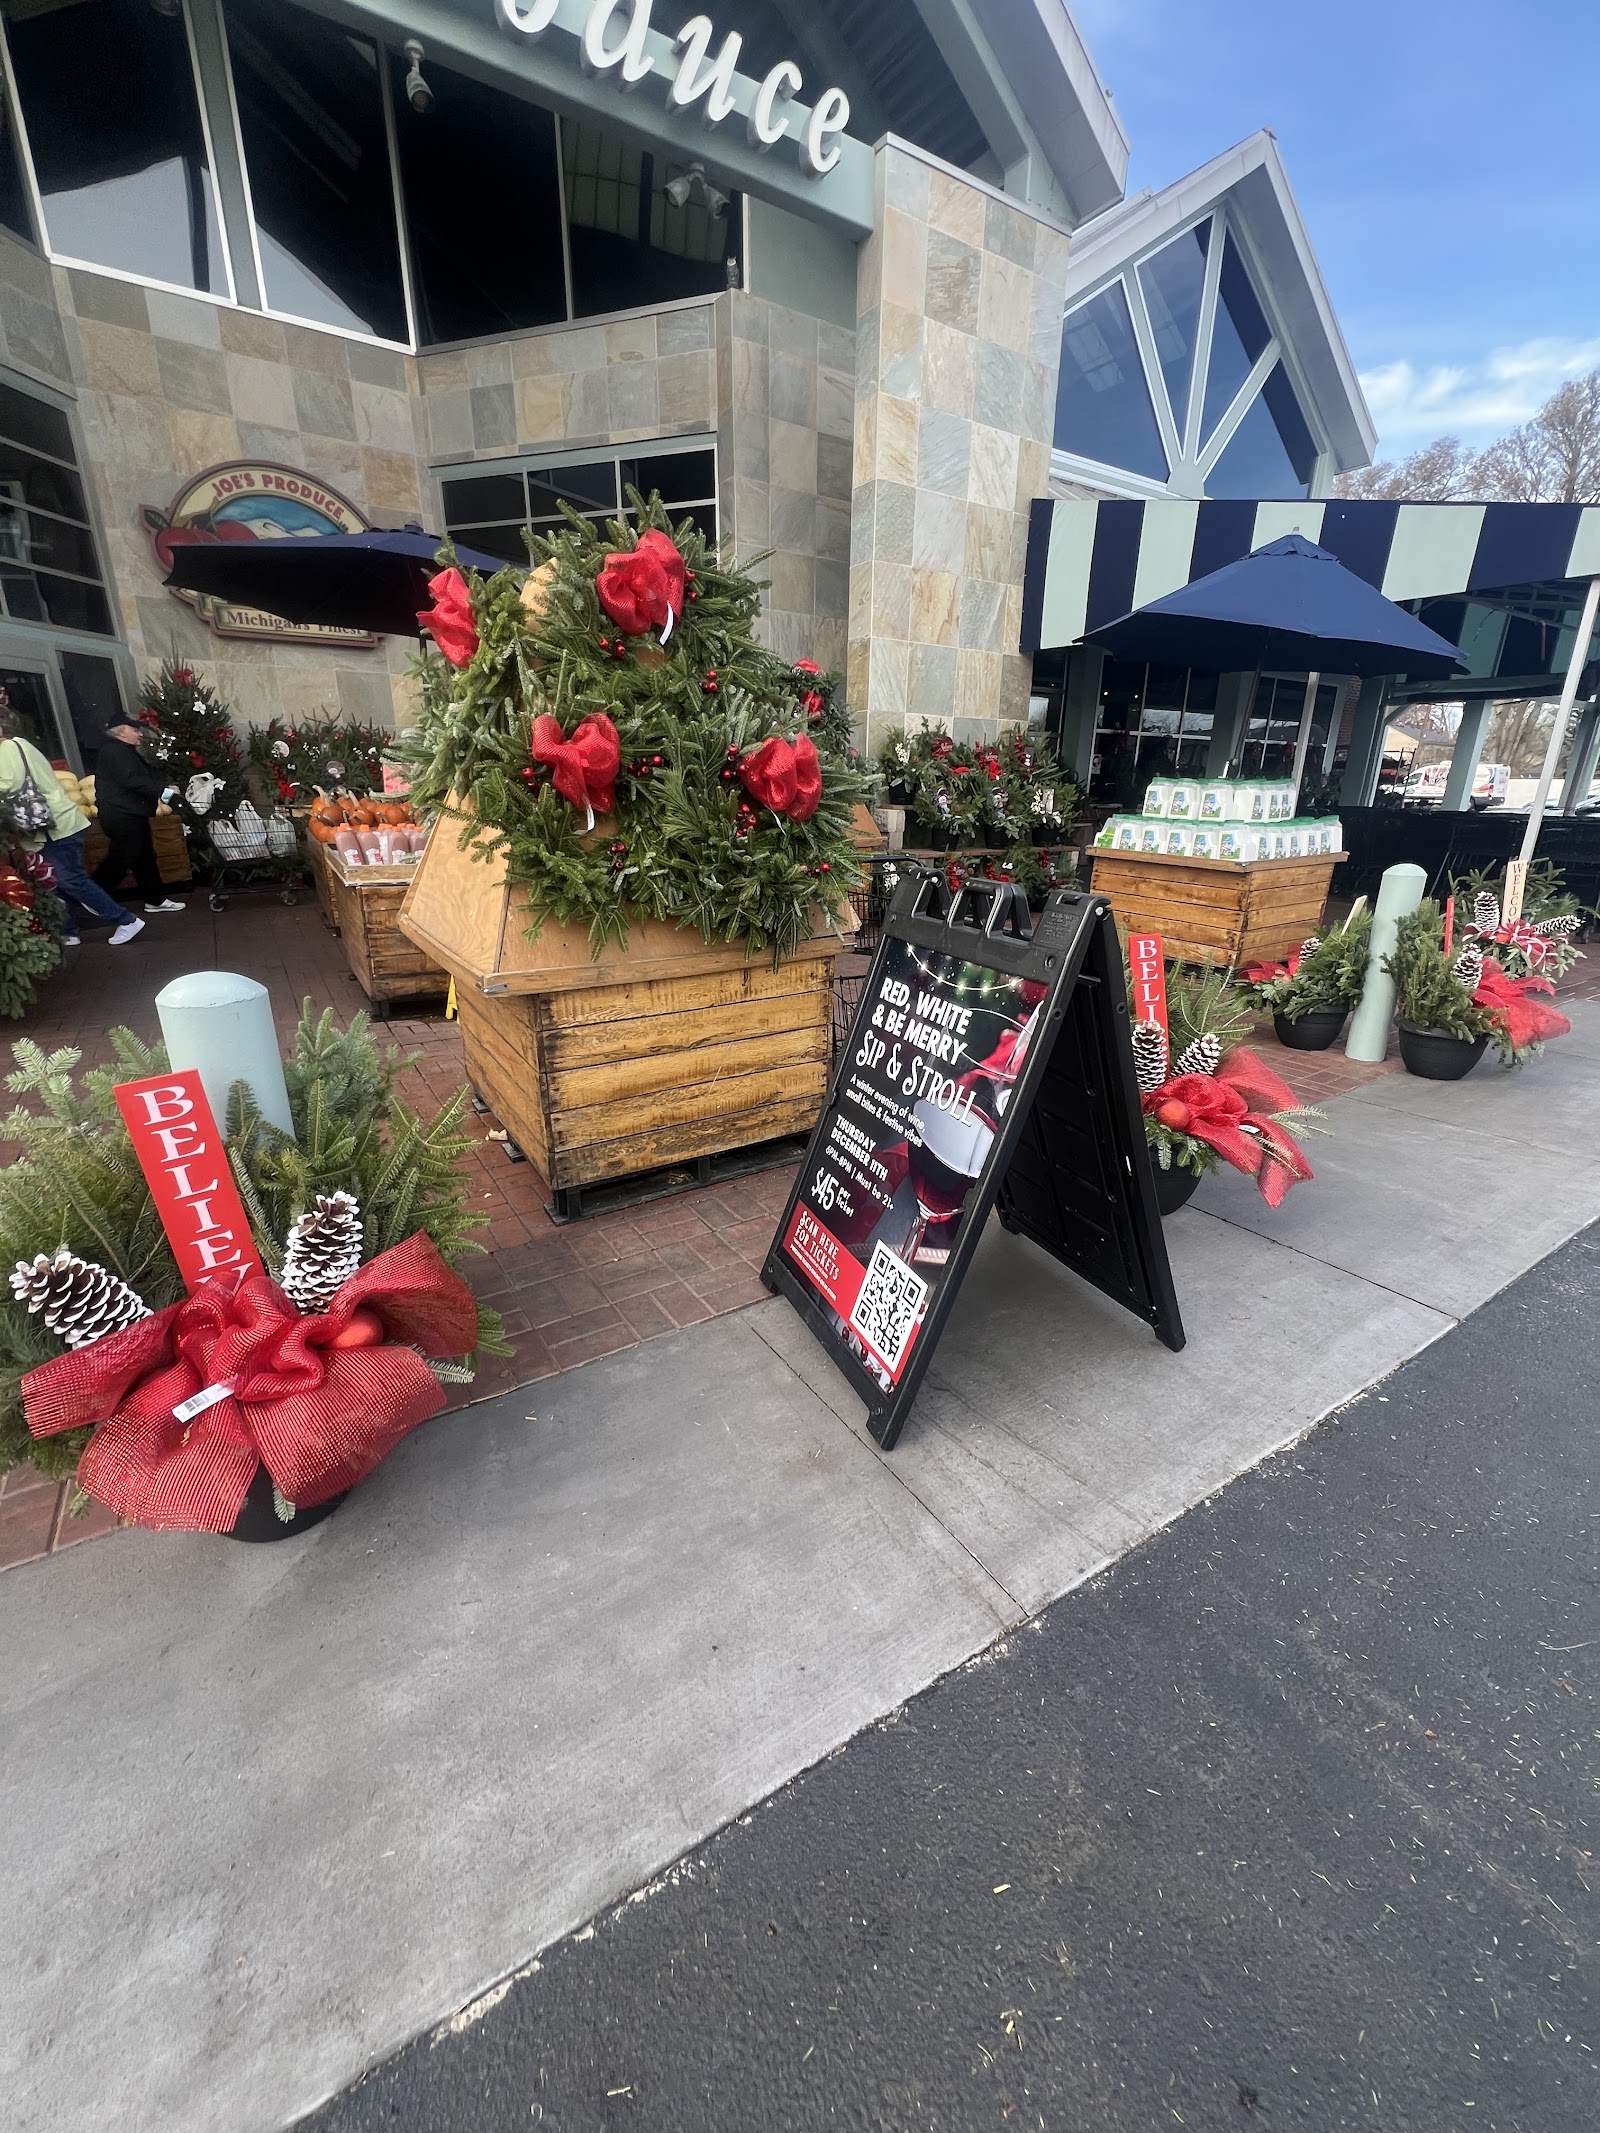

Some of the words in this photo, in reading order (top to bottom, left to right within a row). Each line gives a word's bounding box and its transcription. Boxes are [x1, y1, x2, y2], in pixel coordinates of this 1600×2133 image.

[212, 472, 255, 498] JOE'S
[261, 473, 345, 520] PRODUCE
[1507, 862, 1524, 922] WELCO
[880, 977, 911, 1014] RED,
[915, 990, 973, 1035] WHITE
[871, 1003, 885, 1028] &
[884, 1008, 907, 1037] BE
[903, 1018, 968, 1066] MERRY
[886, 1042, 902, 1081] &
[845, 1087, 862, 1107] small
[861, 1095, 877, 1115] bites
[876, 1106, 882, 1119] &
[882, 1110, 904, 1135] festive
[904, 1124, 923, 1148] vibes
[850, 1073, 856, 1084] A
[855, 1078, 875, 1096] winter
[873, 1090, 899, 1117] evening
[899, 1106, 910, 1119] of
[907, 1111, 926, 1133] wine,
[830, 1126, 870, 1168] DECEMBER
[869, 1158, 889, 1182] 11TH
[835, 1113, 877, 1153] THURSDAY
[811, 1166, 839, 1211] $45
[825, 1144, 852, 1175] 6PM-8PM
[854, 1170, 872, 1191] Must
[871, 1184, 882, 1200] be
[881, 1193, 895, 1211] 21+
[837, 1186, 851, 1199] per
[835, 1196, 855, 1217] ticket
[794, 1224, 810, 1247] FOR
[809, 1240, 840, 1281] TICKETS
[799, 1210, 820, 1239] SCAN
[819, 1231, 840, 1260] HERE
